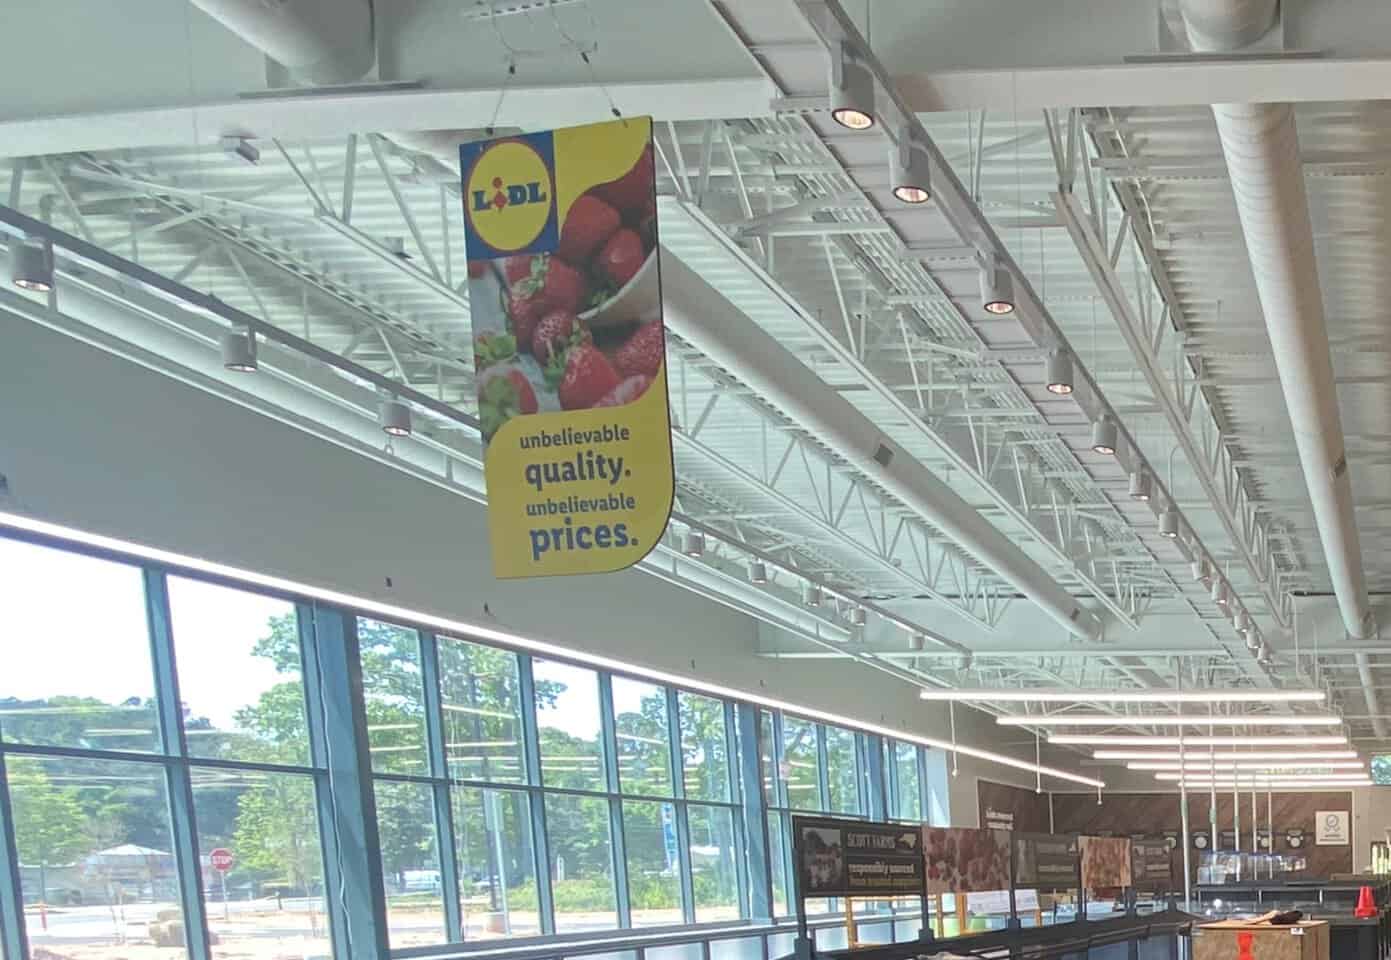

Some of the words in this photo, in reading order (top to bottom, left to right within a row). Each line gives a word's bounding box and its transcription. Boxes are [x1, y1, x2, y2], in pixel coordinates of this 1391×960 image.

[519, 424, 631, 450] unbelievable
[524, 452, 632, 491] quality.
[526, 493, 636, 517] unbelievable
[529, 516, 639, 560] prices.
